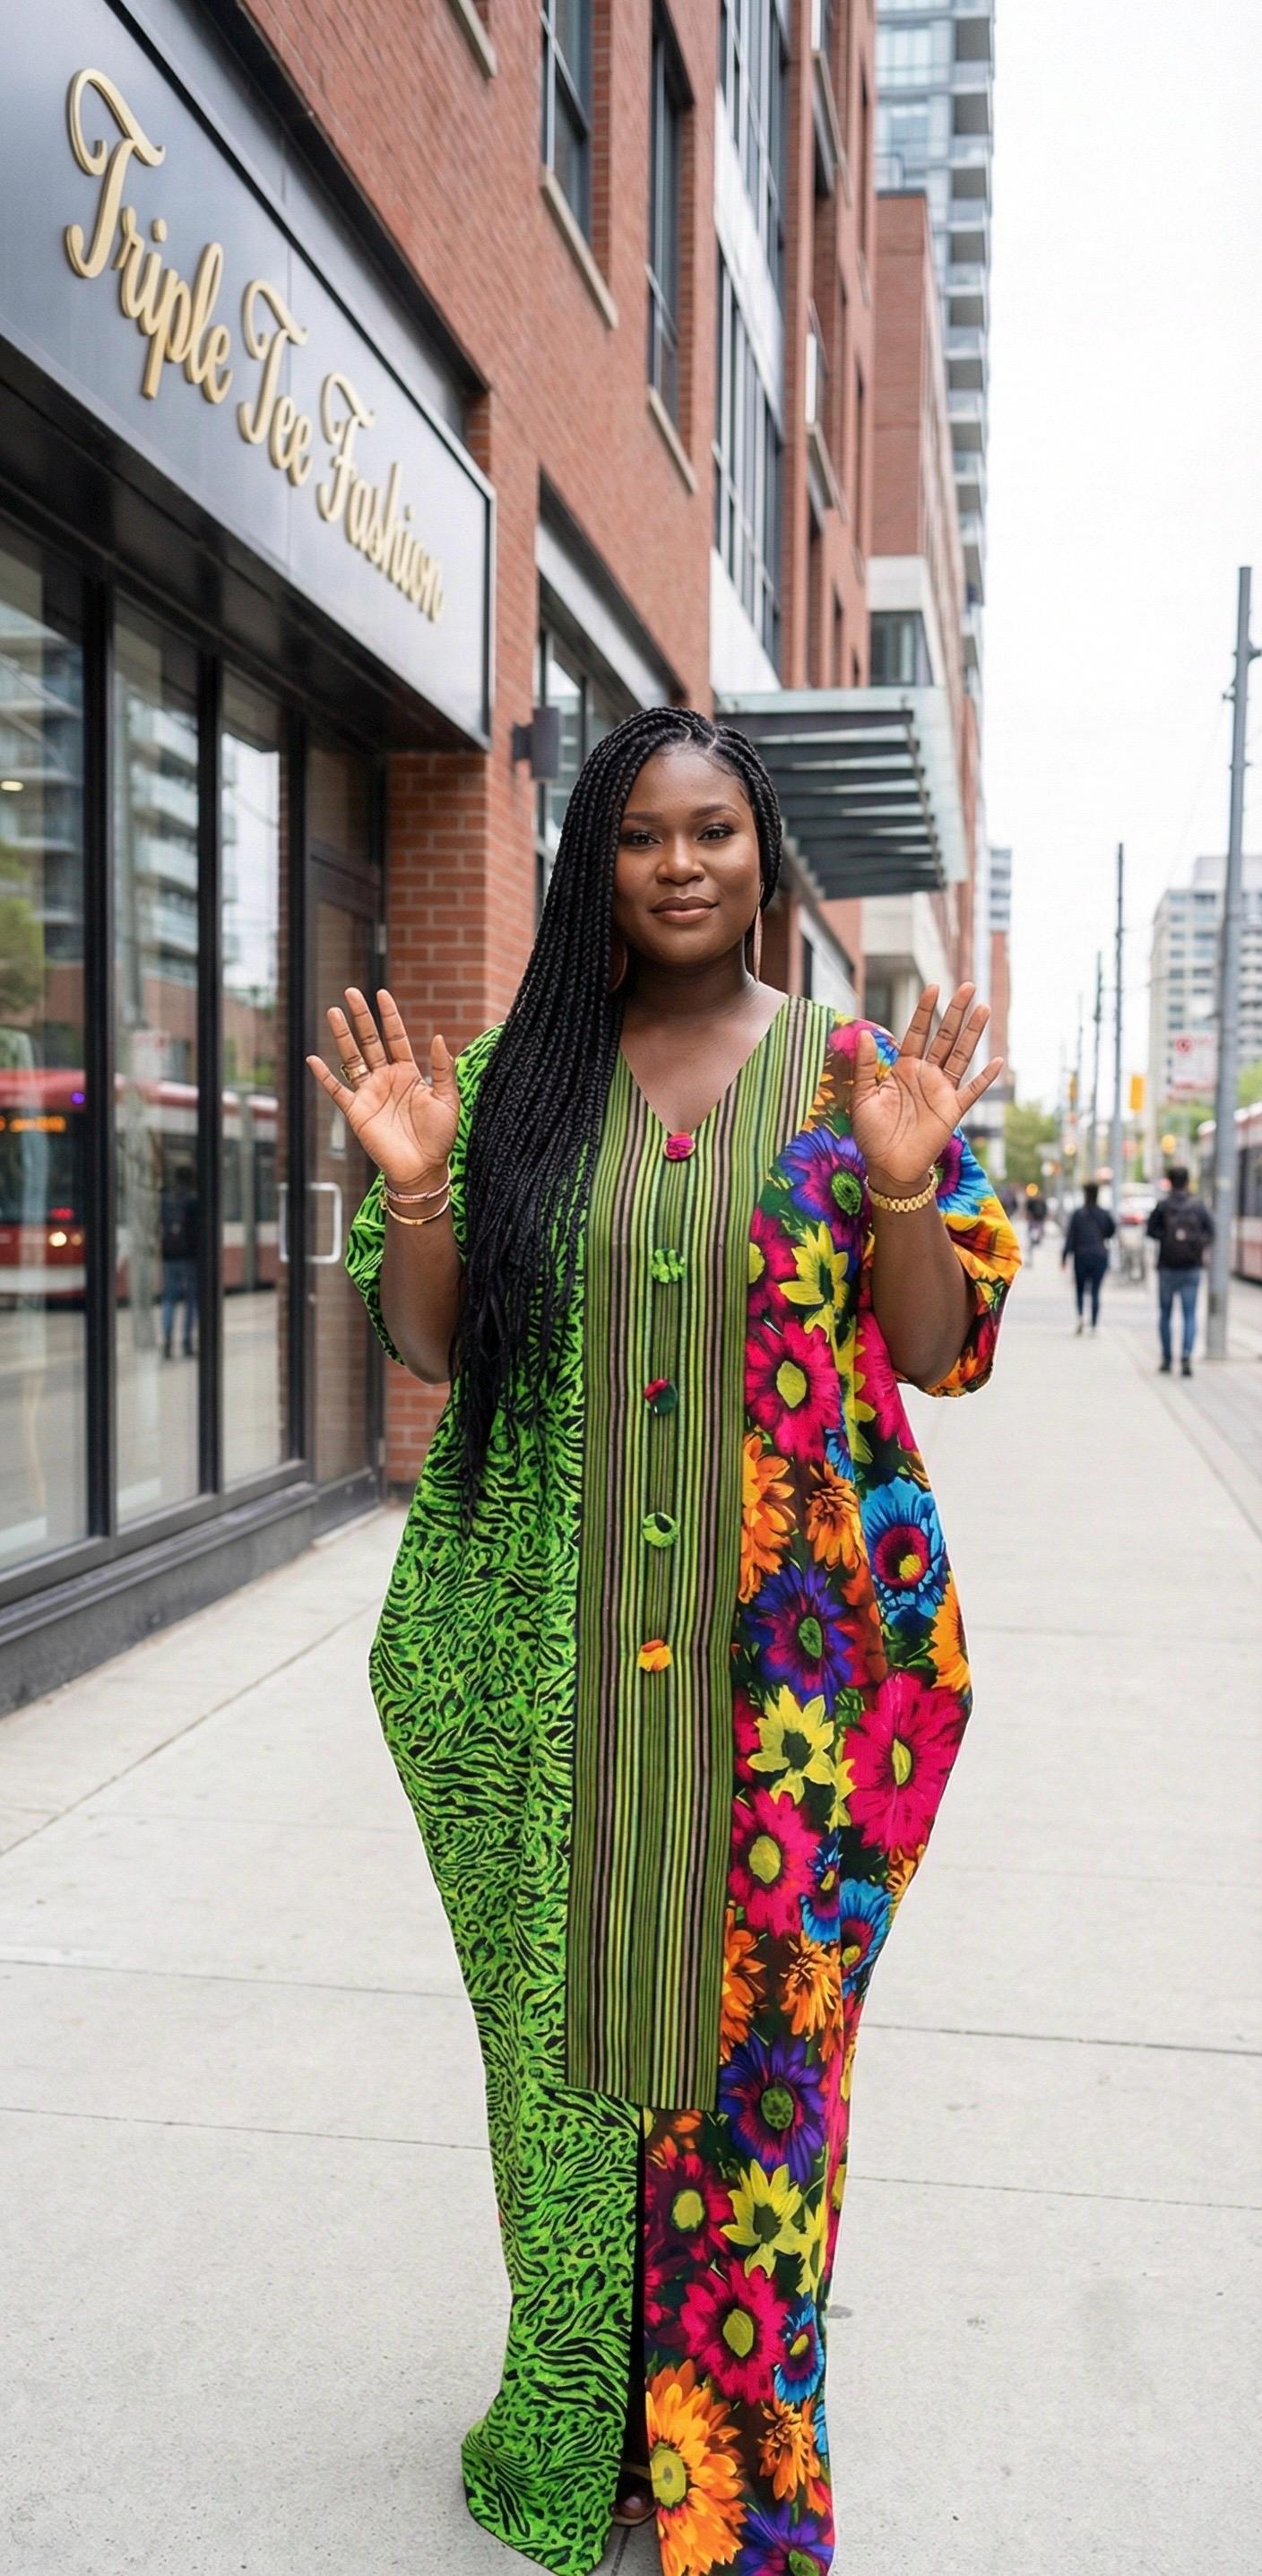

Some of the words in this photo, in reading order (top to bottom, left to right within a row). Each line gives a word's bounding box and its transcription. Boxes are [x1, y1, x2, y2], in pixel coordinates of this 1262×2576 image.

[65, 67, 232, 403] Triple
[238, 279, 313, 487] Tee
[316, 372, 445, 623] Fashion
